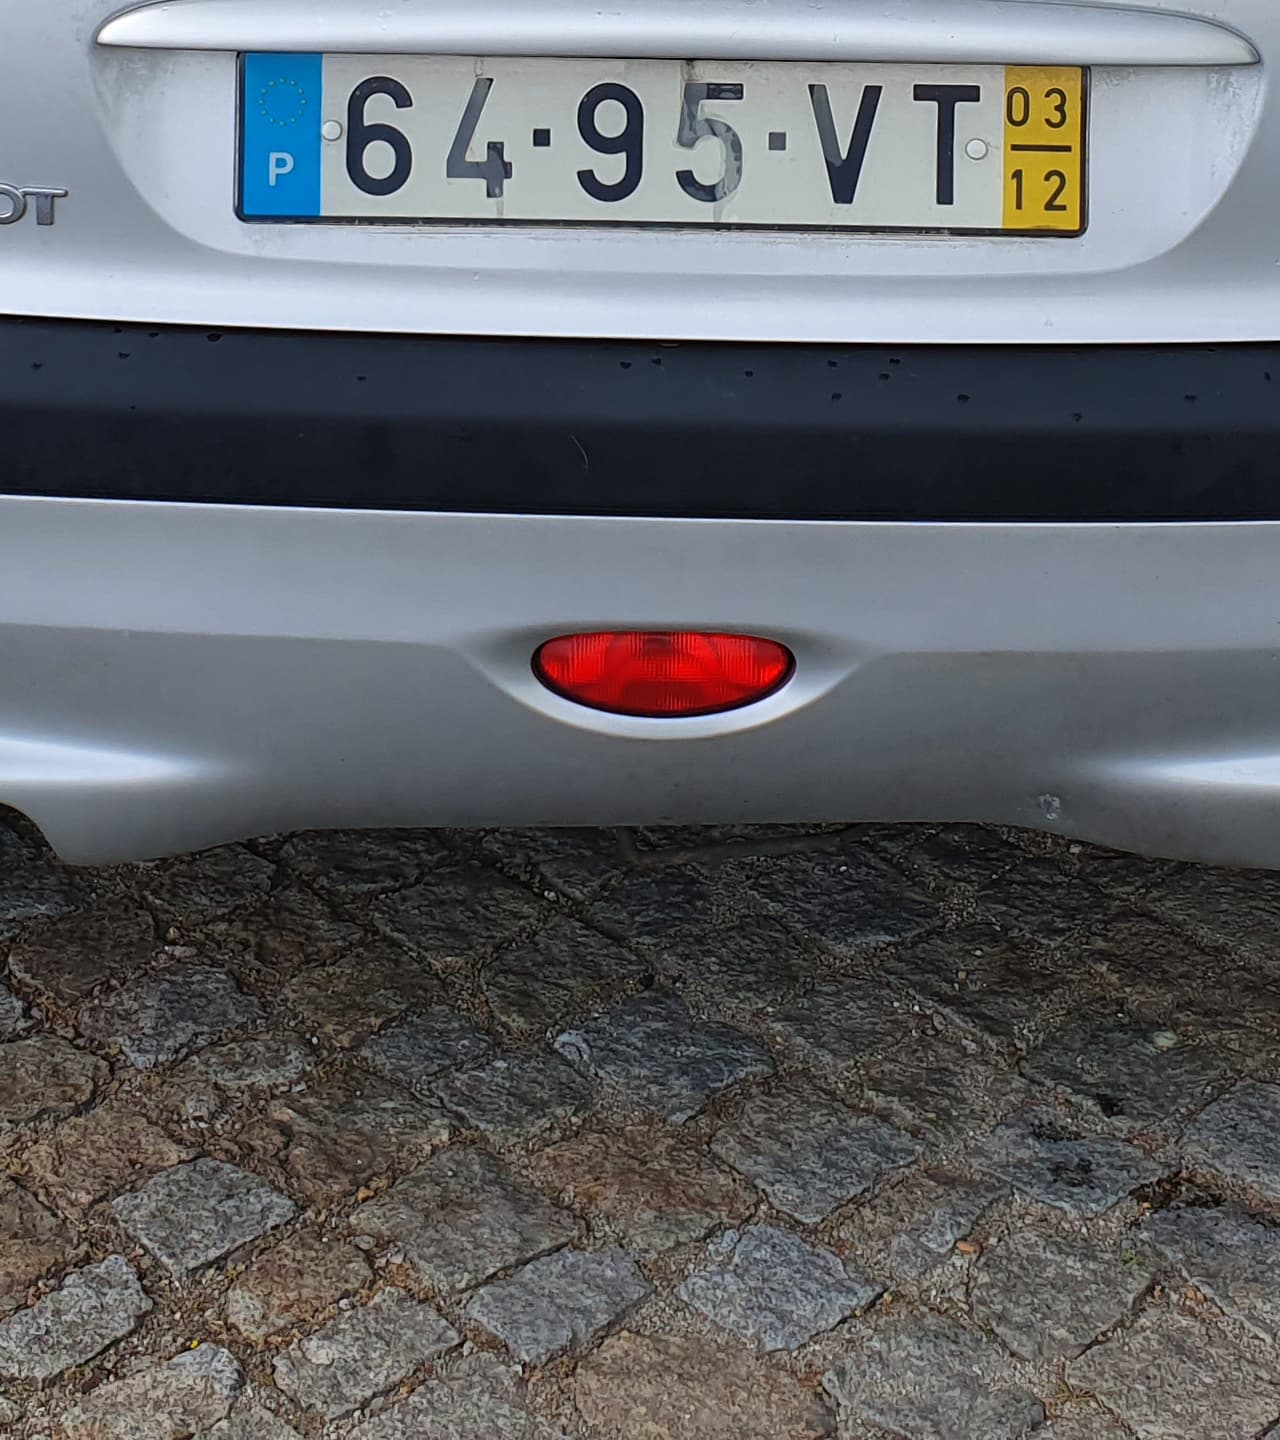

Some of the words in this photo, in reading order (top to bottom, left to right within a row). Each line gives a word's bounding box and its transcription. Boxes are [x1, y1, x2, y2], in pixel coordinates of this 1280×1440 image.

[1006, 86, 1067, 129] 03
[268, 151, 295, 187] P
[1011, 168, 1067, 212] 12
